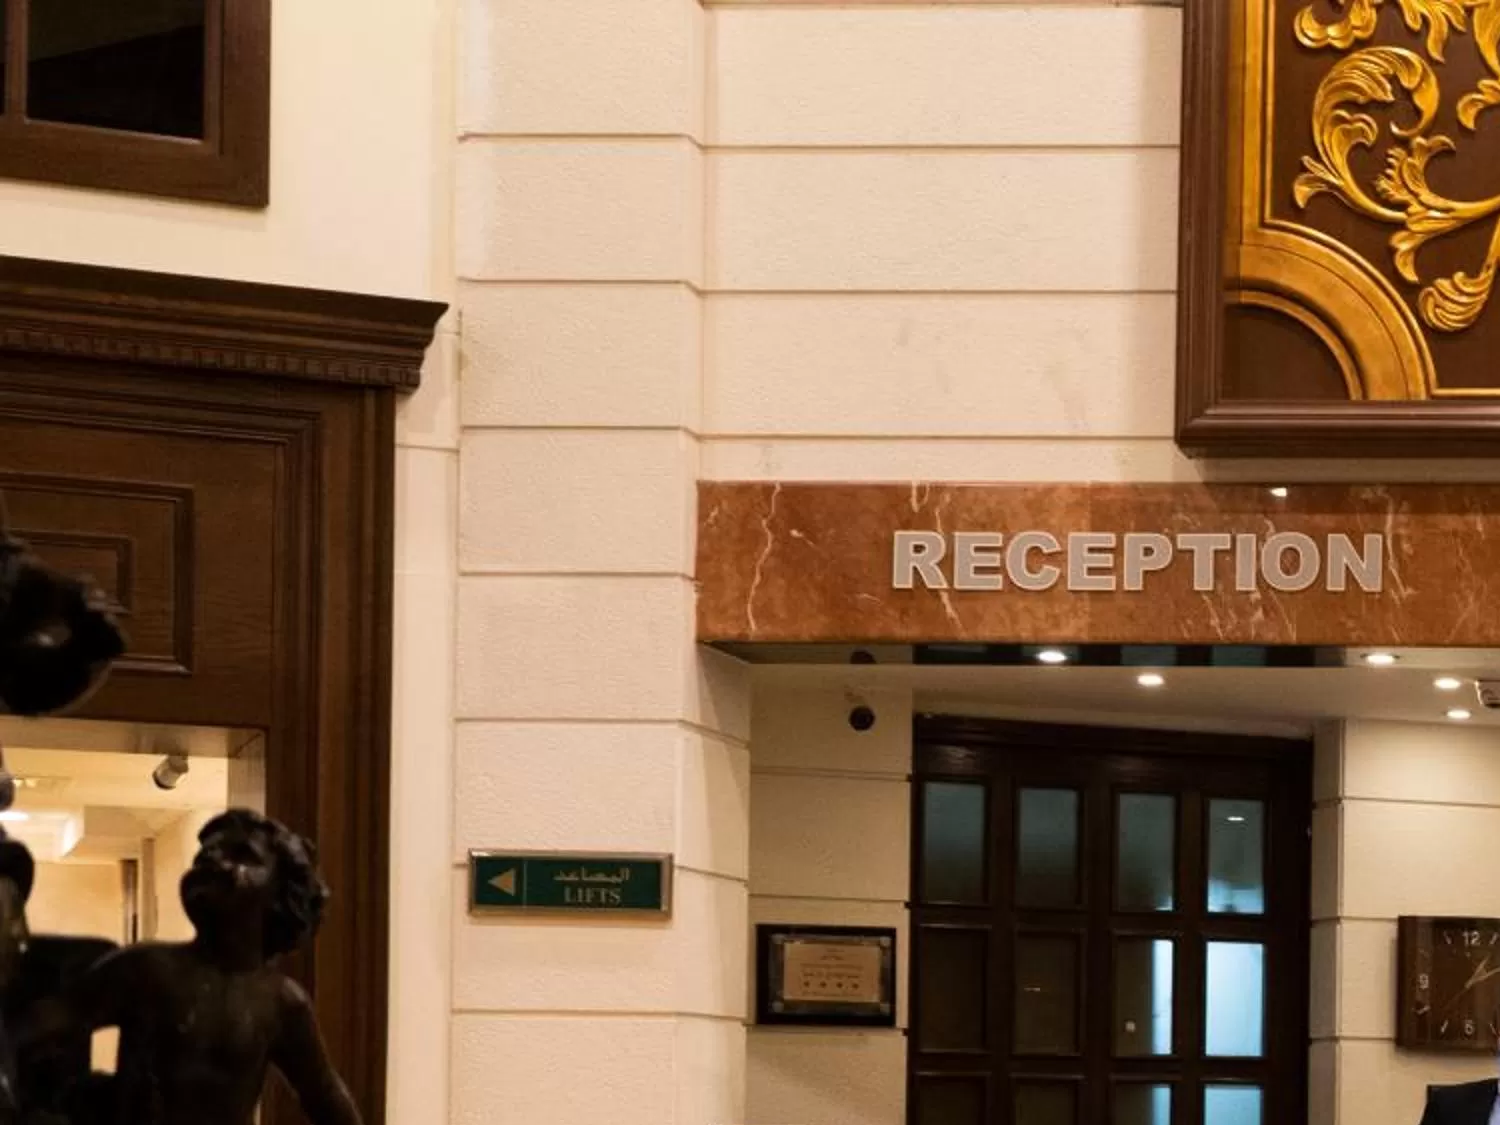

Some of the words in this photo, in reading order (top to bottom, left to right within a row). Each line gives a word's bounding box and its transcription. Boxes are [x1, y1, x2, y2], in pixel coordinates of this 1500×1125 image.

[892, 530, 1384, 593] RECEPTION
[563, 886, 623, 905] LIFTS
[1462, 929, 1481, 946] 12
